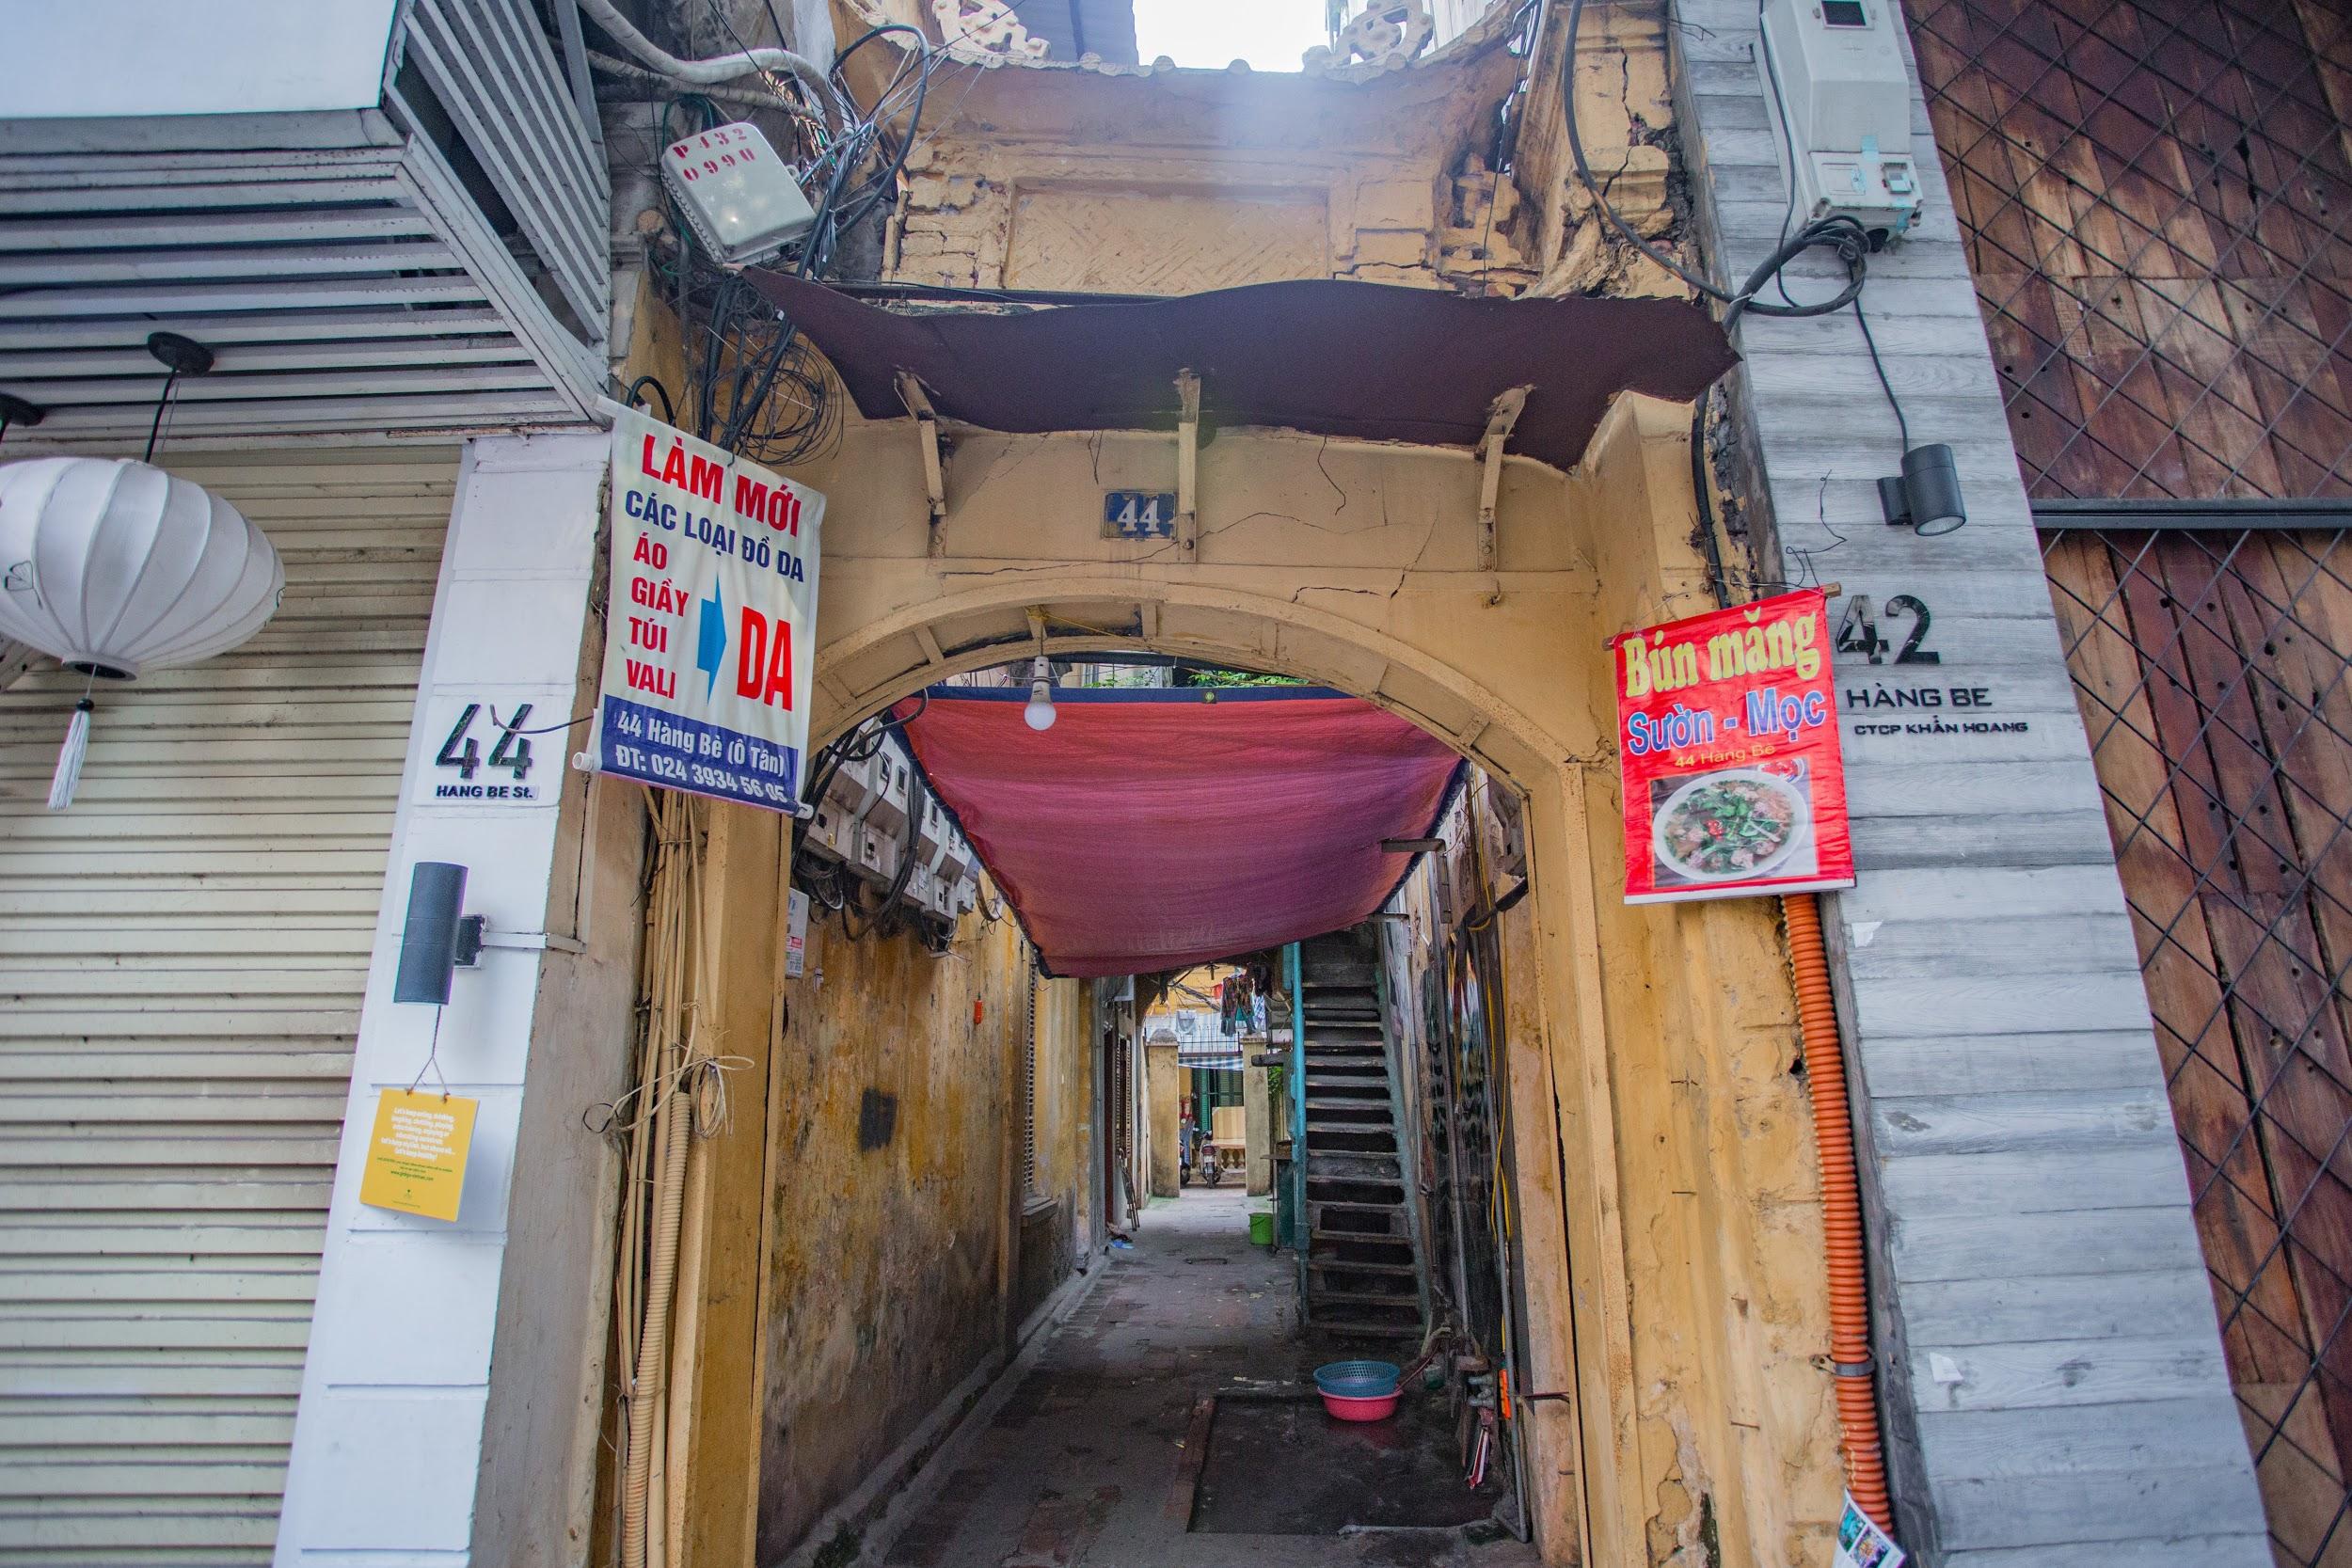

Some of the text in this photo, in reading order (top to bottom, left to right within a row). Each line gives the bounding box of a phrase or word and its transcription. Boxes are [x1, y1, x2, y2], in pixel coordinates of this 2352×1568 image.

[642, 434, 802, 538] LÀM MỚI
[625, 490, 804, 582] CÁC LOẠI ĐỒ DA
[1116, 499, 1160, 532] 44
[632, 531, 668, 570] ÁO
[631, 577, 690, 617] GIẦY
[628, 616, 668, 653] TÚI
[1623, 606, 1820, 698] Bún măng
[1836, 594, 1940, 664] 42
[627, 658, 675, 700] VALI
[737, 606, 793, 712] DA
[1846, 682, 1943, 707] HÀNG
[435, 704, 532, 779] 44
[617, 711, 784, 777] 44 Hàng Bè (Ô Tân)
[1628, 703, 1714, 755] Sườn
[1745, 687, 1826, 742] Mọc
[1854, 723, 1901, 736] CTCP
[1963, 722, 2028, 734] HOANG
[616, 744, 788, 803] ĐT: 024 3934 56 05
[1675, 754, 1694, 768] 44
[436, 784, 533, 798] HANG BE St.
